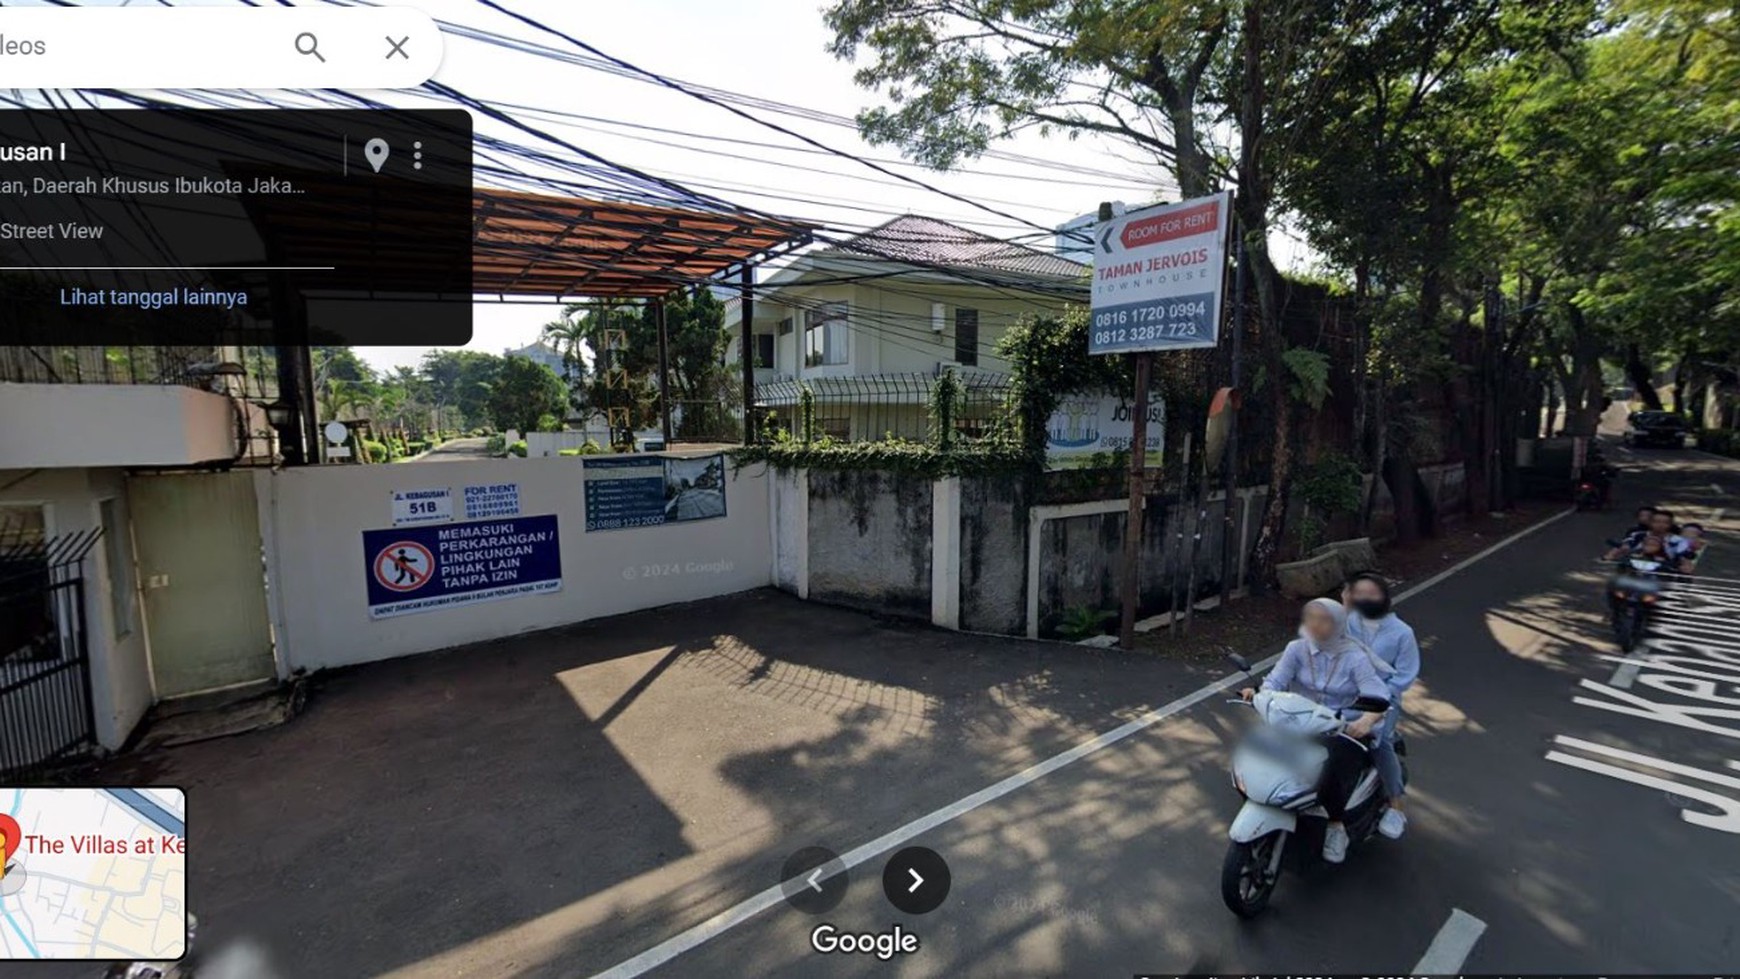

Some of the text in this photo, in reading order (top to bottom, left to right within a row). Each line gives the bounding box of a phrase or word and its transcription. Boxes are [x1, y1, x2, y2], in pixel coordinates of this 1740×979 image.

[1128, 211, 1214, 240] ROOM FOR RENT
[1098, 248, 1208, 280] TAMAN JERVOIS
[1096, 300, 1206, 327] 0816 1720 0994
[1095, 321, 1196, 345] 0812 3287 723
[464, 483, 517, 496] FOR RENT
[409, 501, 437, 514] 51B
[438, 523, 514, 540] MEMASUKI
[623, 517, 640, 528] 123
[642, 515, 665, 525] 2000
[439, 531, 546, 552] PERKARANGAN
[440, 544, 533, 565] LINGKUNGAN
[441, 557, 520, 577] PIHAK LAIN
[442, 569, 518, 588] TANPA IZIN
